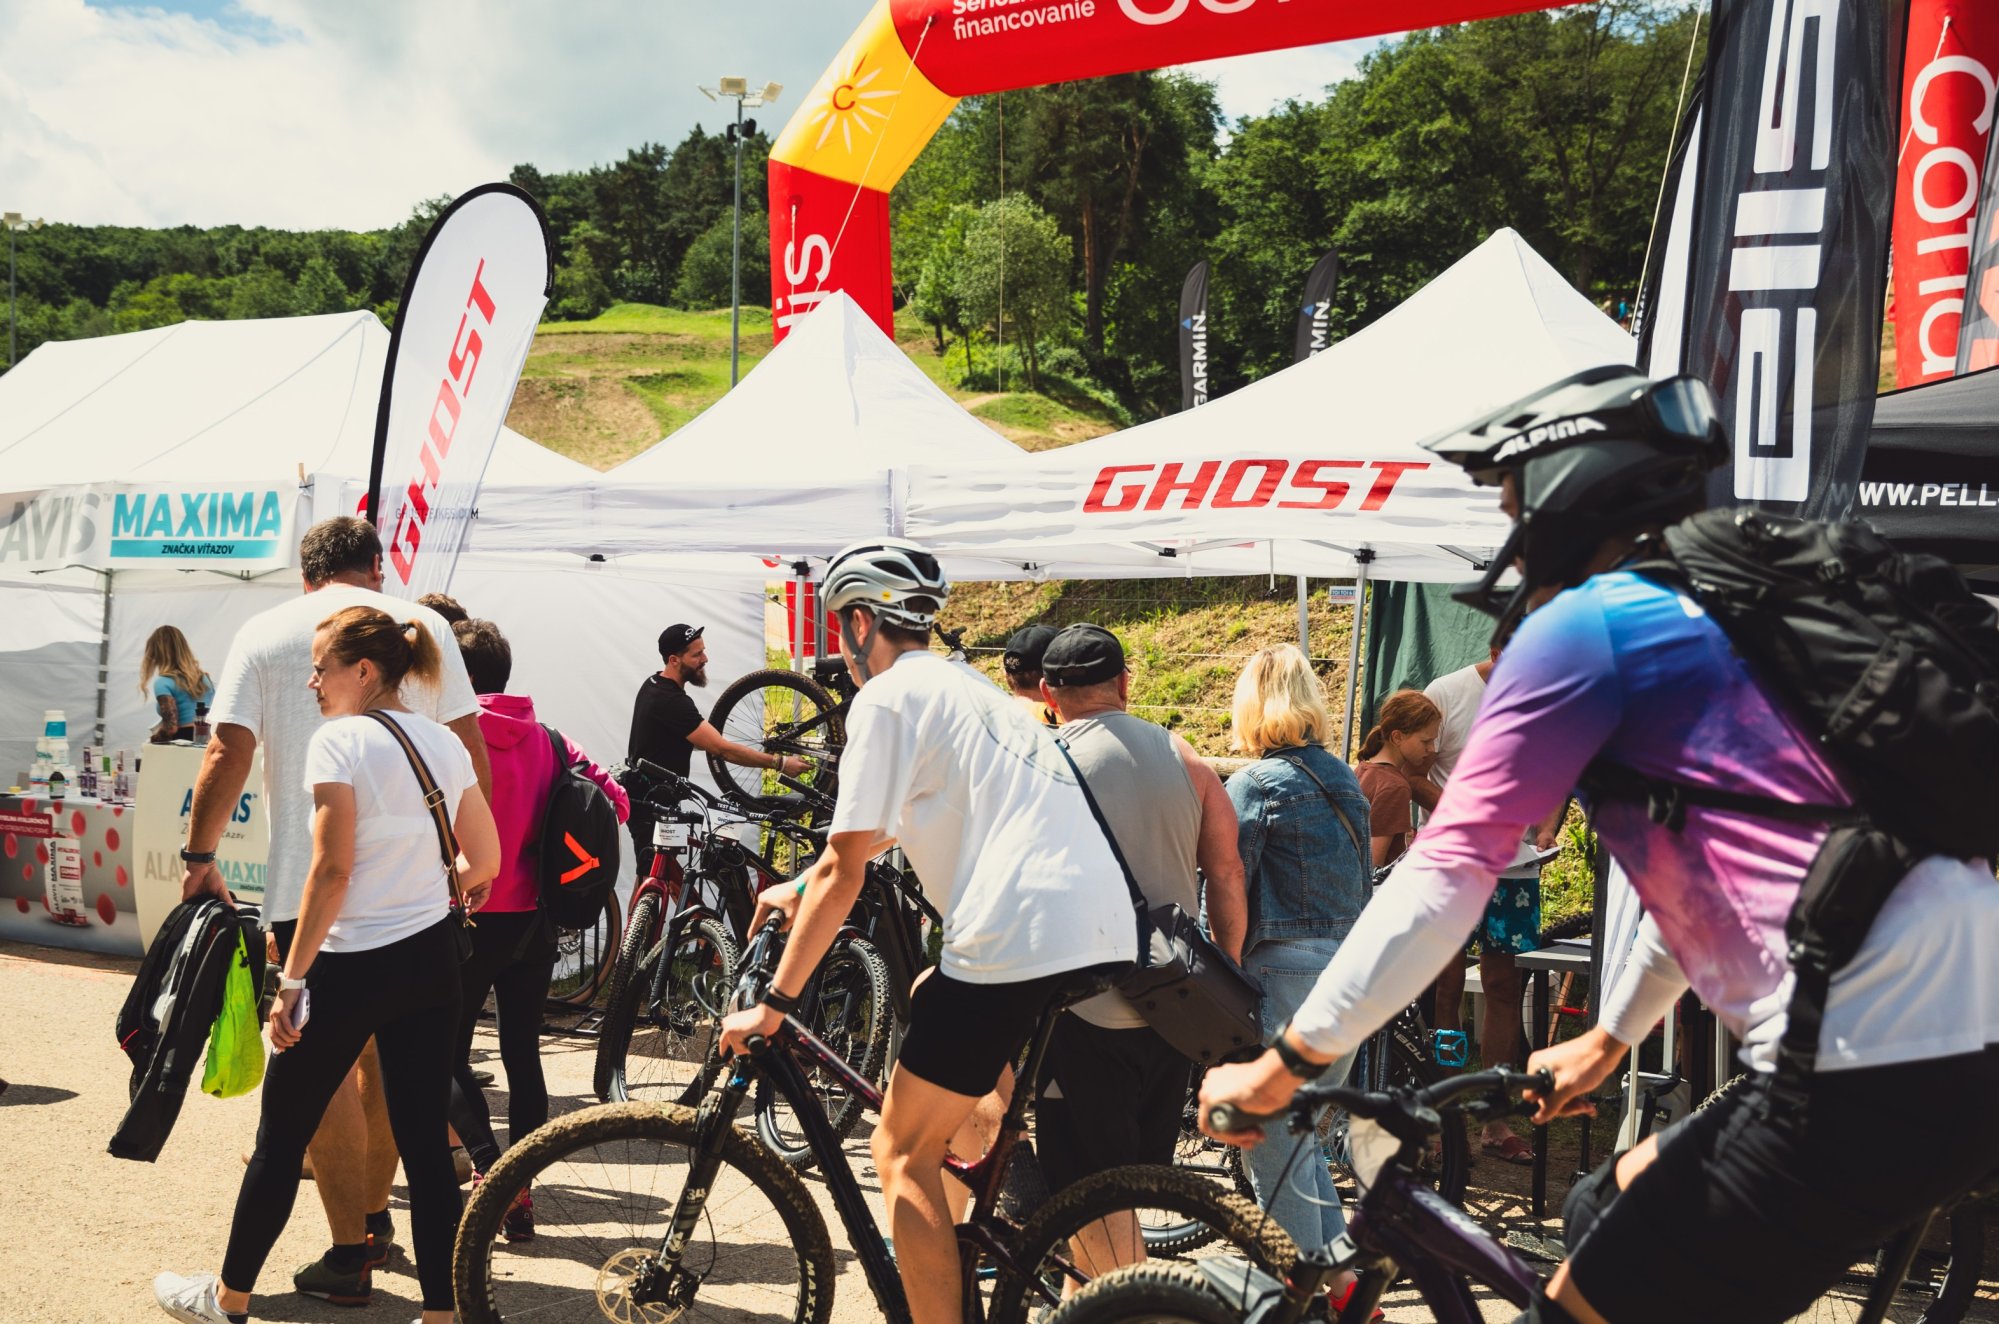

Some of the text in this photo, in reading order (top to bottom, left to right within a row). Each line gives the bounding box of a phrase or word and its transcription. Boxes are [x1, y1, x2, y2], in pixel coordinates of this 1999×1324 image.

[953, 1, 1096, 40] financovanie
[776, 234, 831, 331] is
[389, 256, 497, 586] GHOST
[1492, 416, 1607, 462] ALPINA
[1082, 459, 1431, 513] GHOST
[1830, 481, 1999, 506] WWW.PELL
[112, 491, 282, 537] MAXIMA
[161, 543, 196, 555] ZNAČKA
[686, 1187, 706, 1201] 34
[802, 1258, 818, 1324] MAXX
